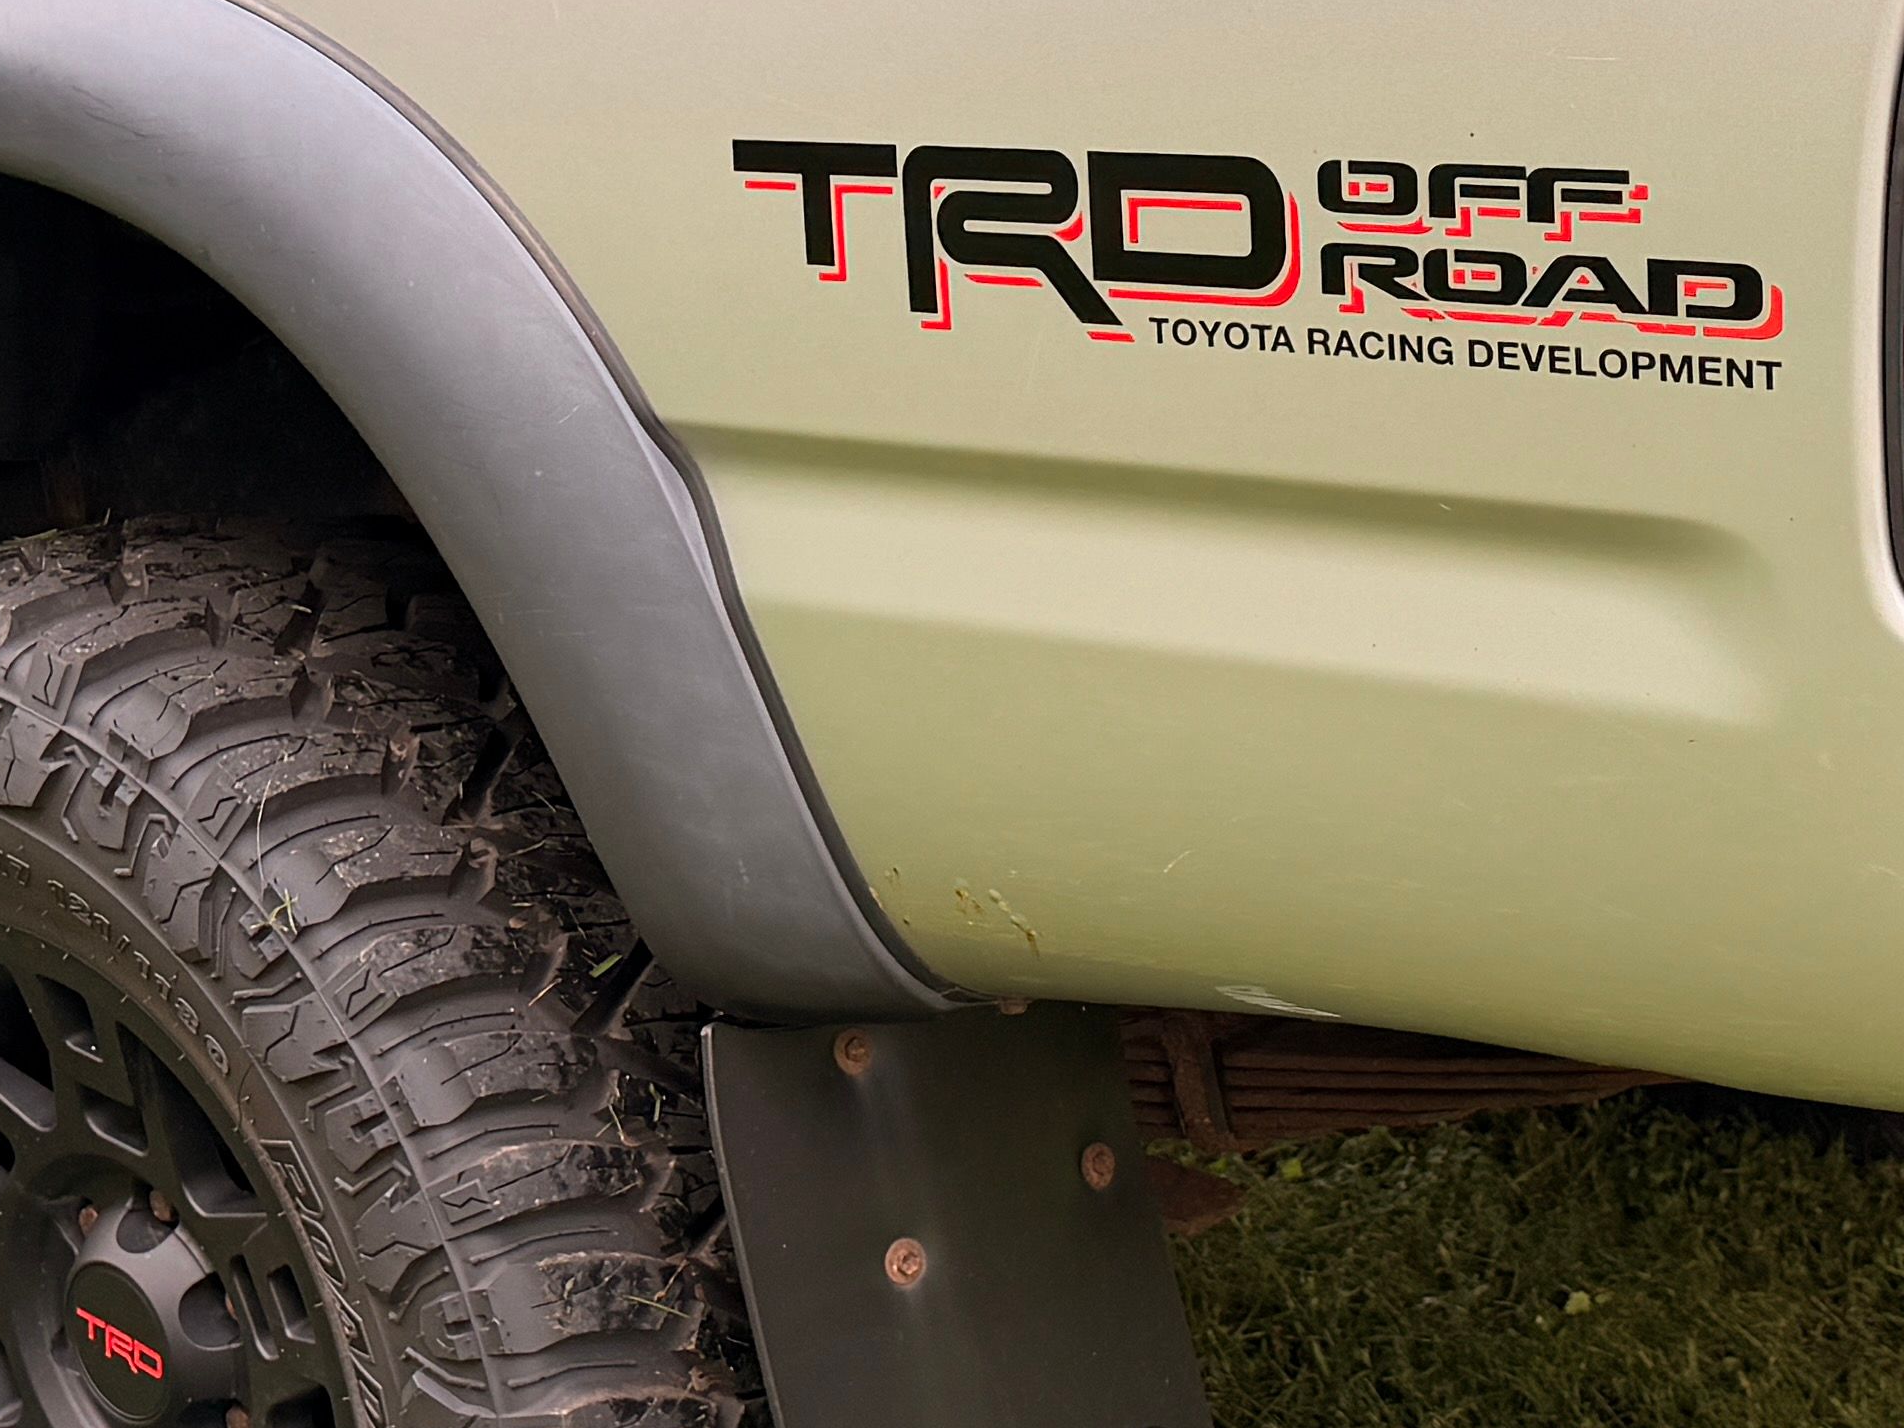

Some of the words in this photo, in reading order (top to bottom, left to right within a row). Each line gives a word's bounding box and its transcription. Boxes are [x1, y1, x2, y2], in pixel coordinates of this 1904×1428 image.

[731, 138, 1300, 342] TRD
[1317, 159, 1648, 242] OFF
[1318, 241, 1784, 341] ROAD
[1148, 316, 1295, 354] TOYOTA
[1307, 330, 1454, 366] RACING
[1469, 339, 1783, 390] DEVELOPMENT
[76, 1307, 164, 1380] TRD
